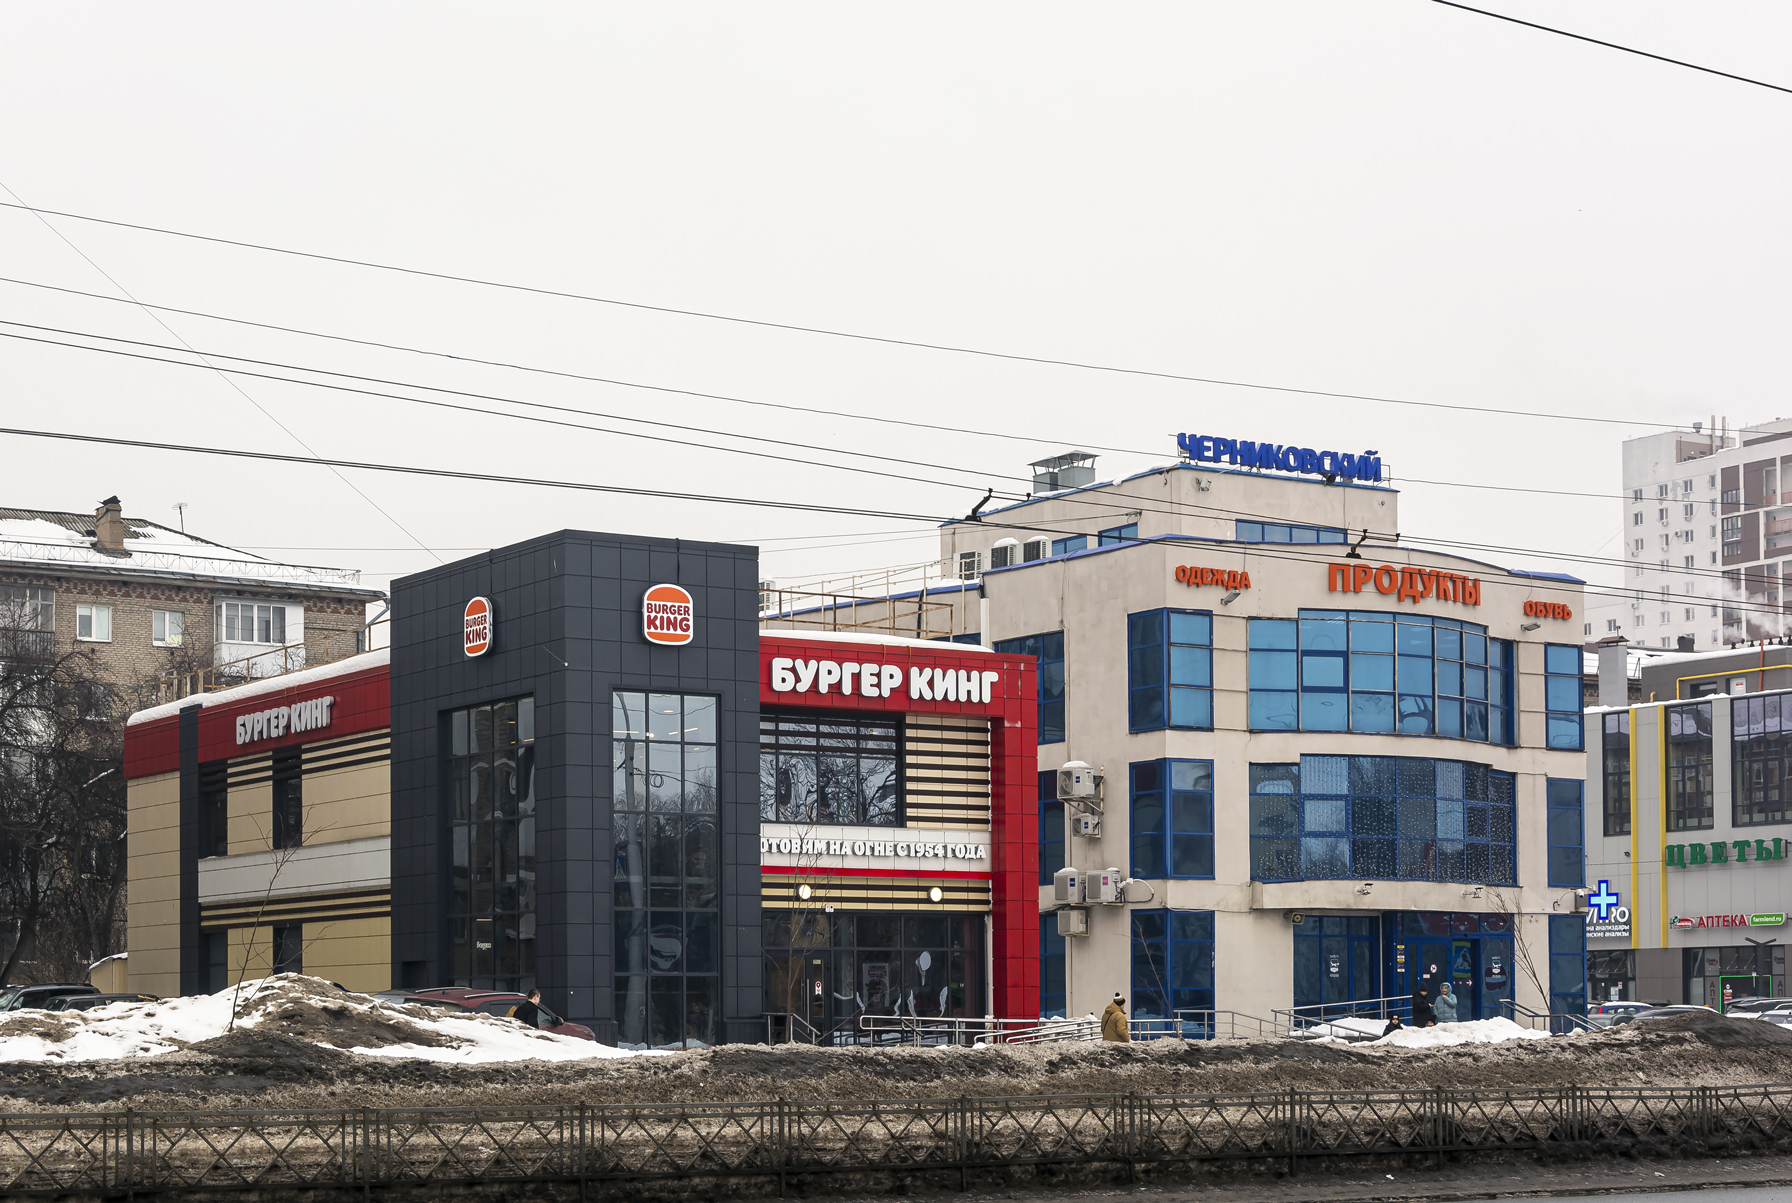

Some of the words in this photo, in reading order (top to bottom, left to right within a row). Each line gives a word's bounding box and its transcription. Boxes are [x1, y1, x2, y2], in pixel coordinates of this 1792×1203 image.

[1177, 432, 1382, 482] ЧЕРНИКОВСКИЙ
[1175, 564, 1252, 591] ОДЕЖДА
[1328, 562, 1481, 606] ПРОДУКТЫ
[646, 602, 691, 617] BURGER
[1523, 600, 1573, 620] ОБУВЬ
[465, 614, 487, 628] BURGER
[646, 615, 691, 633] KING
[465, 625, 488, 646] KING
[771, 657, 903, 698] БУРГЕР
[909, 666, 999, 704] КИНГ
[236, 706, 290, 745] БУРГЕР
[290, 695, 335, 734] КИНГ
[829, 840, 852, 856] НА
[855, 841, 895, 856] ОГНЕ
[896, 843, 907, 857] С
[909, 842, 945, 859] 1954
[947, 844, 986, 859] ГОДА
[1665, 837, 1784, 869] ЦВЕТЫ
[1698, 914, 1748, 928] АПТЕКА
